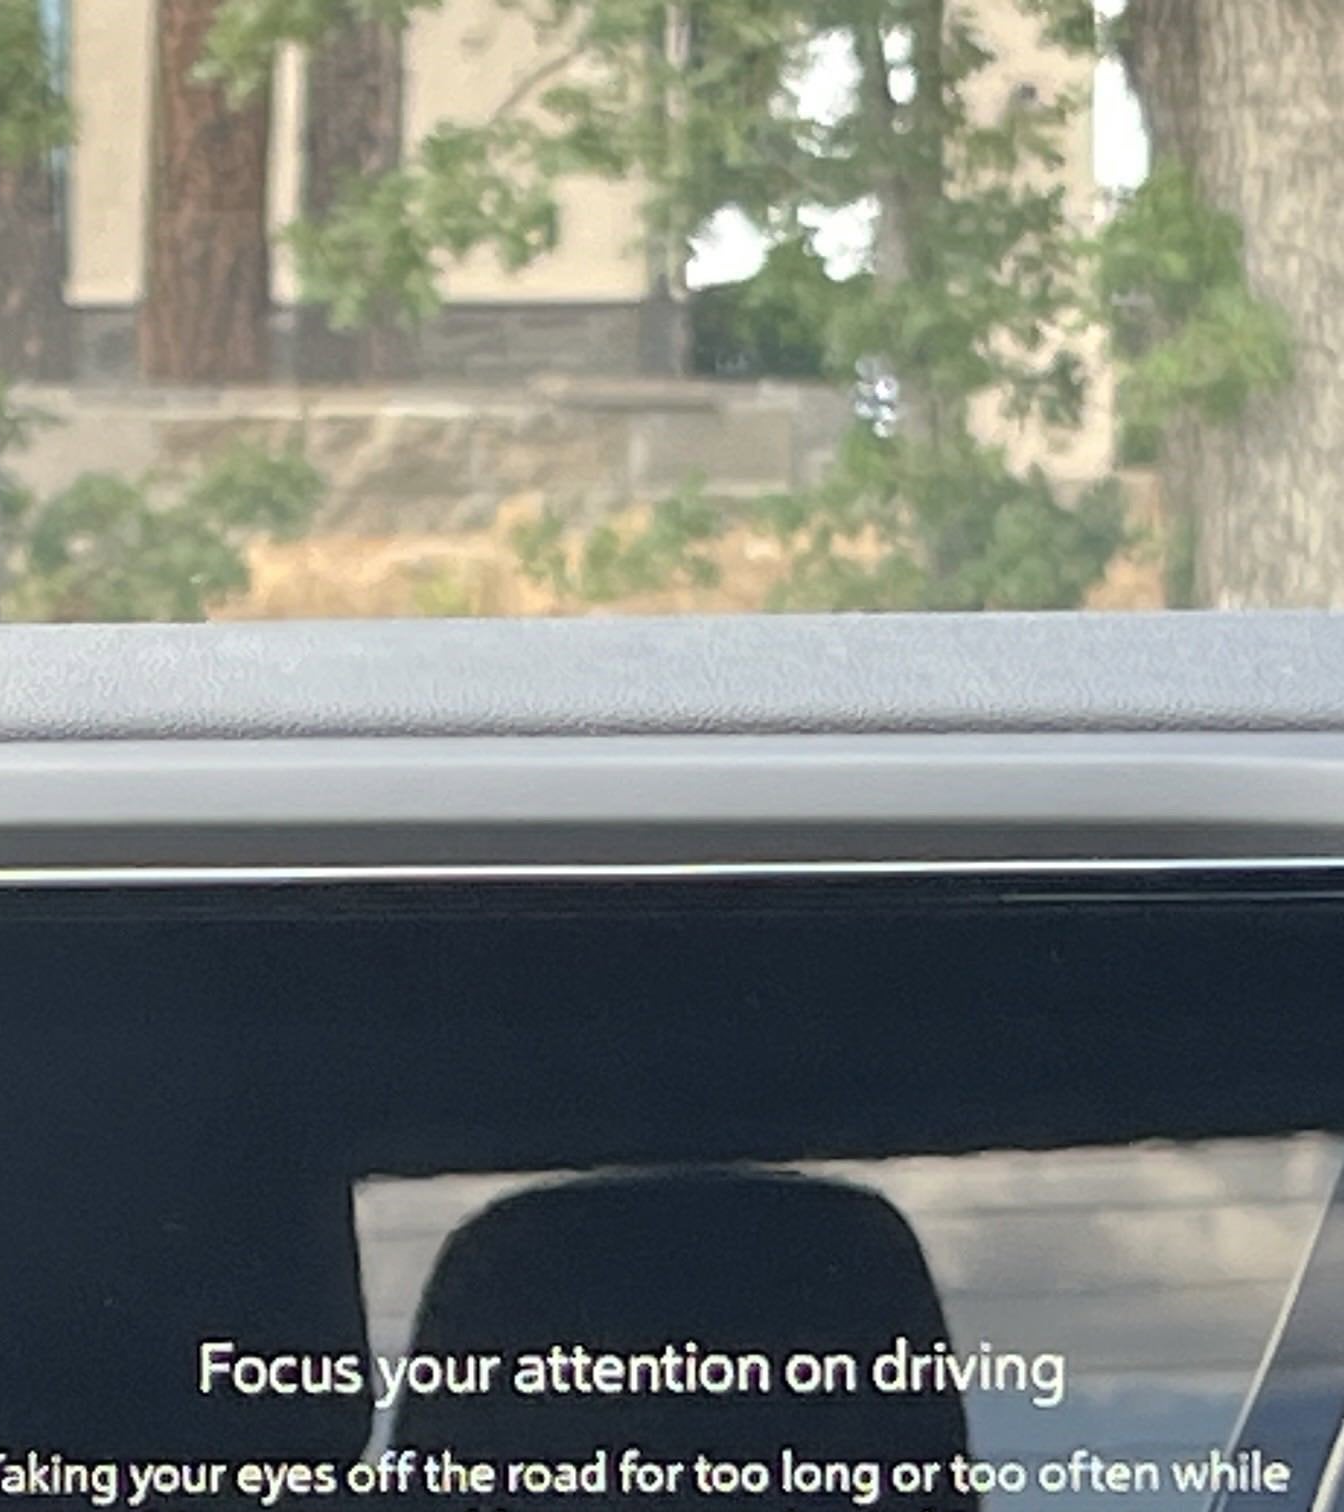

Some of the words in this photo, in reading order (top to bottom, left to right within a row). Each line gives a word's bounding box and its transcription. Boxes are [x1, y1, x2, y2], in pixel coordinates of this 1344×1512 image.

[199, 1341, 363, 1395] Focus
[377, 1353, 502, 1408] your
[513, 1342, 772, 1395] attention
[784, 1352, 859, 1395] on
[871, 1336, 1065, 1408] driving
[128, 1463, 228, 1506] your
[236, 1463, 338, 1506] eyes
[346, 1448, 416, 1495] off
[423, 1450, 497, 1495] the
[506, 1450, 609, 1495] road
[618, 1448, 685, 1495] for
[692, 1454, 771, 1495] too
[781, 1449, 881, 1505] long
[891, 1460, 941, 1495] or
[951, 1454, 1029, 1495] too
[1037, 1448, 1160, 1495] often
[1170, 1449, 1292, 1495] while
